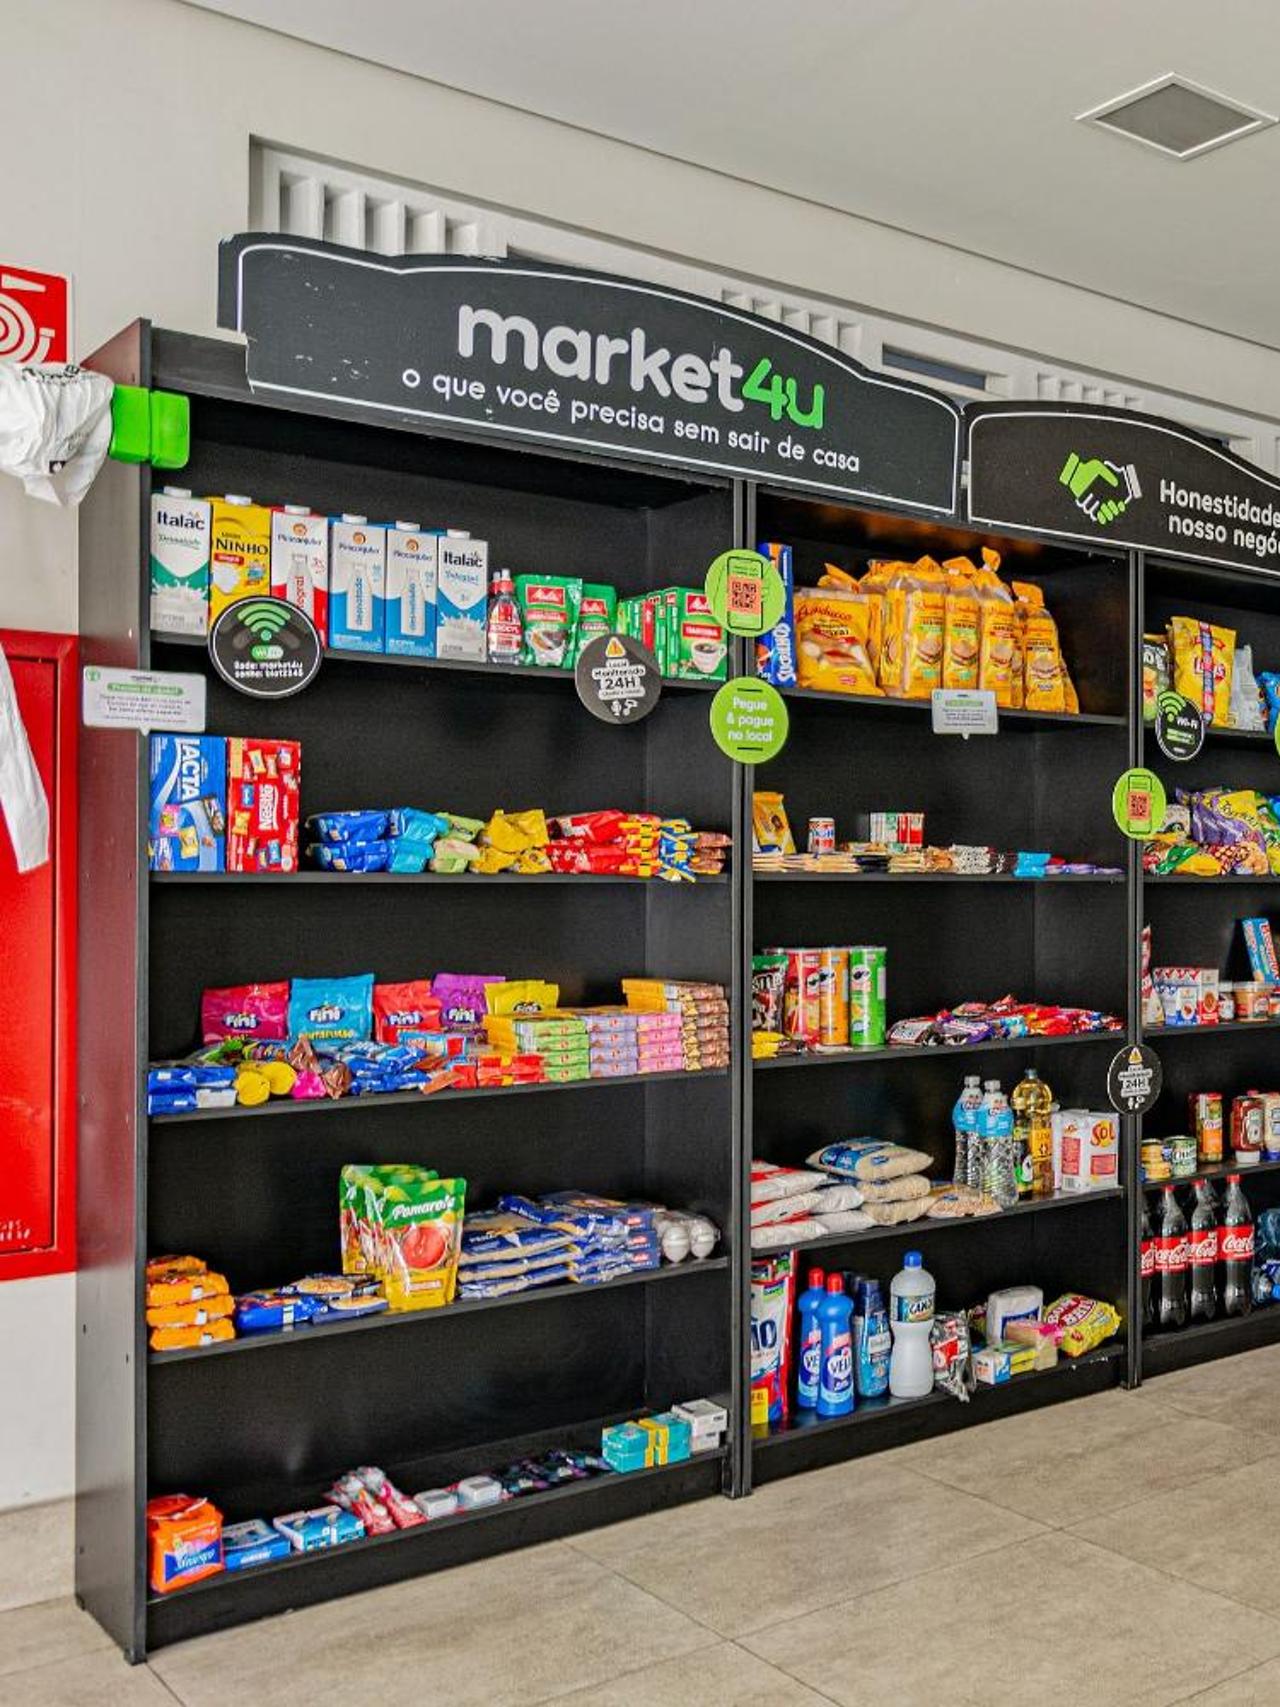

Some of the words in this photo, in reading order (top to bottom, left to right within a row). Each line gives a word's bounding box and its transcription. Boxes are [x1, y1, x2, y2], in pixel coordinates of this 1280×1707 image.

[402, 369, 421, 390] o
[432, 370, 486, 402] que
[496, 384, 560, 415] você
[570, 399, 665, 436] precisa
[674, 417, 721, 446] sem
[728, 426, 771, 456] sair
[777, 434, 806, 462] de
[812, 446, 861, 473] casa
[157, 511, 206, 531] Italac
[1168, 512, 1227, 543] nosso
[216, 538, 269, 556] NINHO
[443, 551, 484, 568] Italac
[605, 677, 636, 690] 24H
